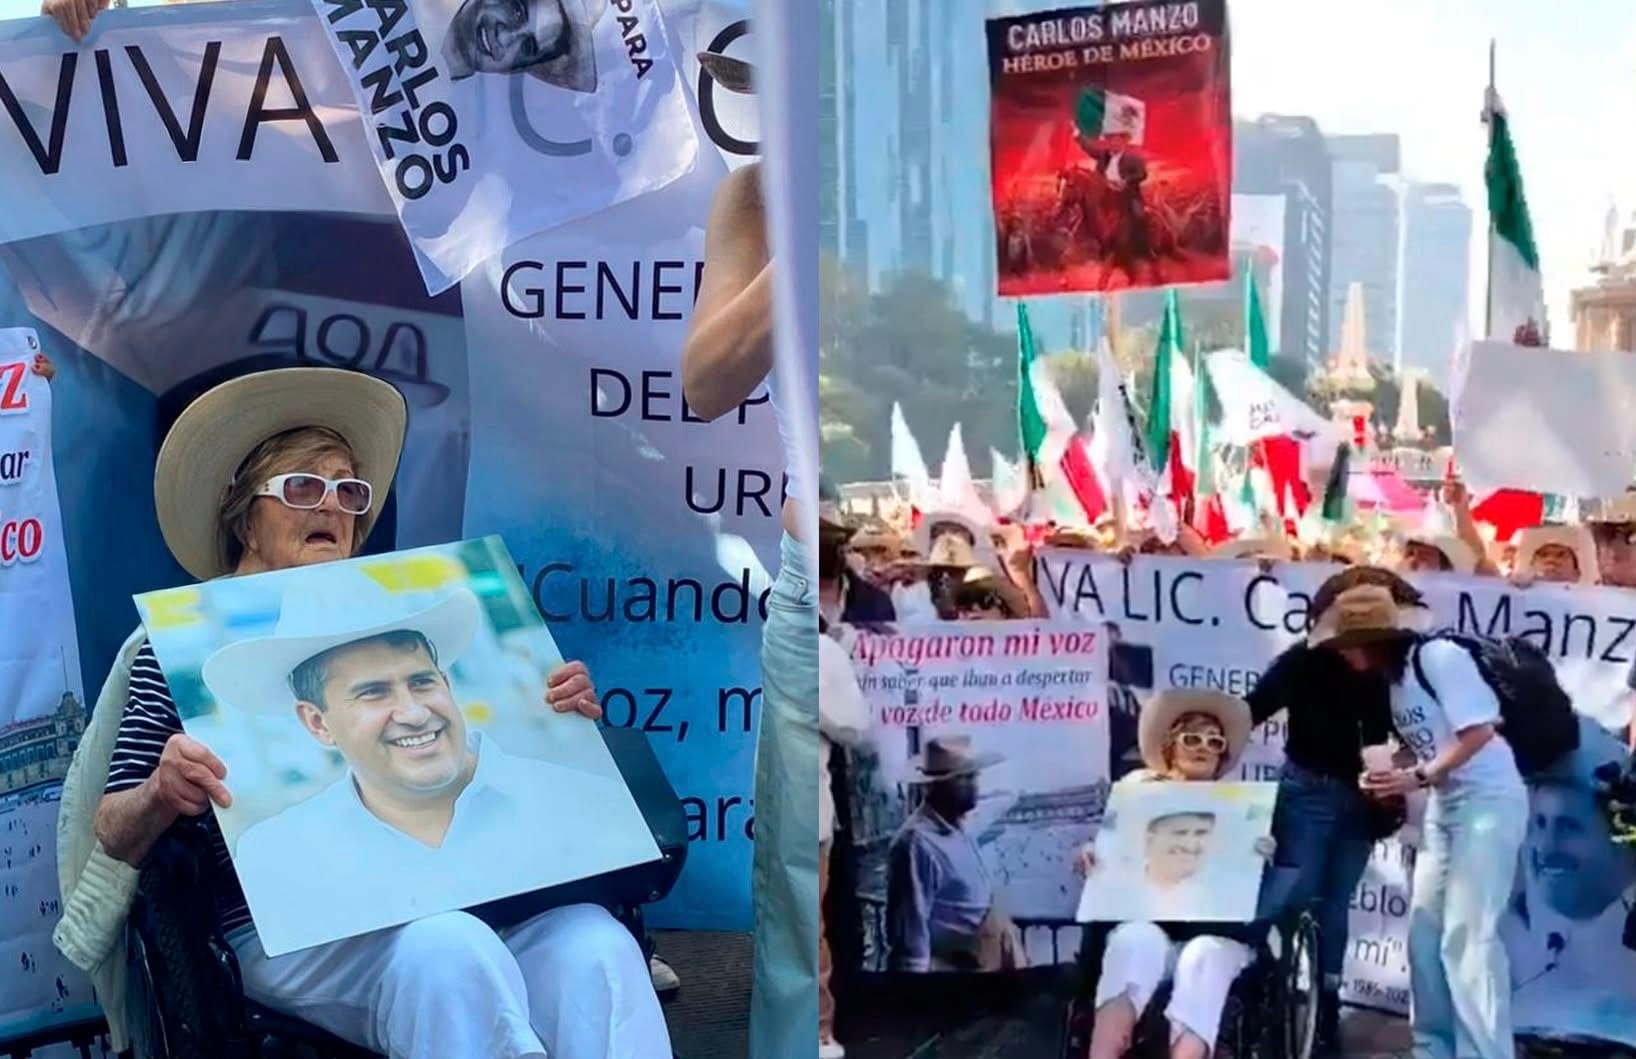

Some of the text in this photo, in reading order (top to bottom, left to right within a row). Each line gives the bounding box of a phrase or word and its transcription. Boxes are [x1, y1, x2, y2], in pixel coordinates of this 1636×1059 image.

[1008, 1, 1199, 50] CARLOS MANZO
[1084, 45, 1114, 64] DE
[1119, 33, 1212, 57] MÉXICO
[0, 36, 340, 175] VIVA
[685, 466, 789, 518] UR
[1123, 566, 1220, 627] LIC.
[1244, 575, 1313, 635] Ca
[850, 627, 1096, 668] Apagaron mi voz
[928, 675, 958, 693] que
[1001, 673, 1012, 687] a
[601, 687, 689, 742] oz,
[881, 703, 919, 725] voz
[959, 697, 1013, 723] todo
